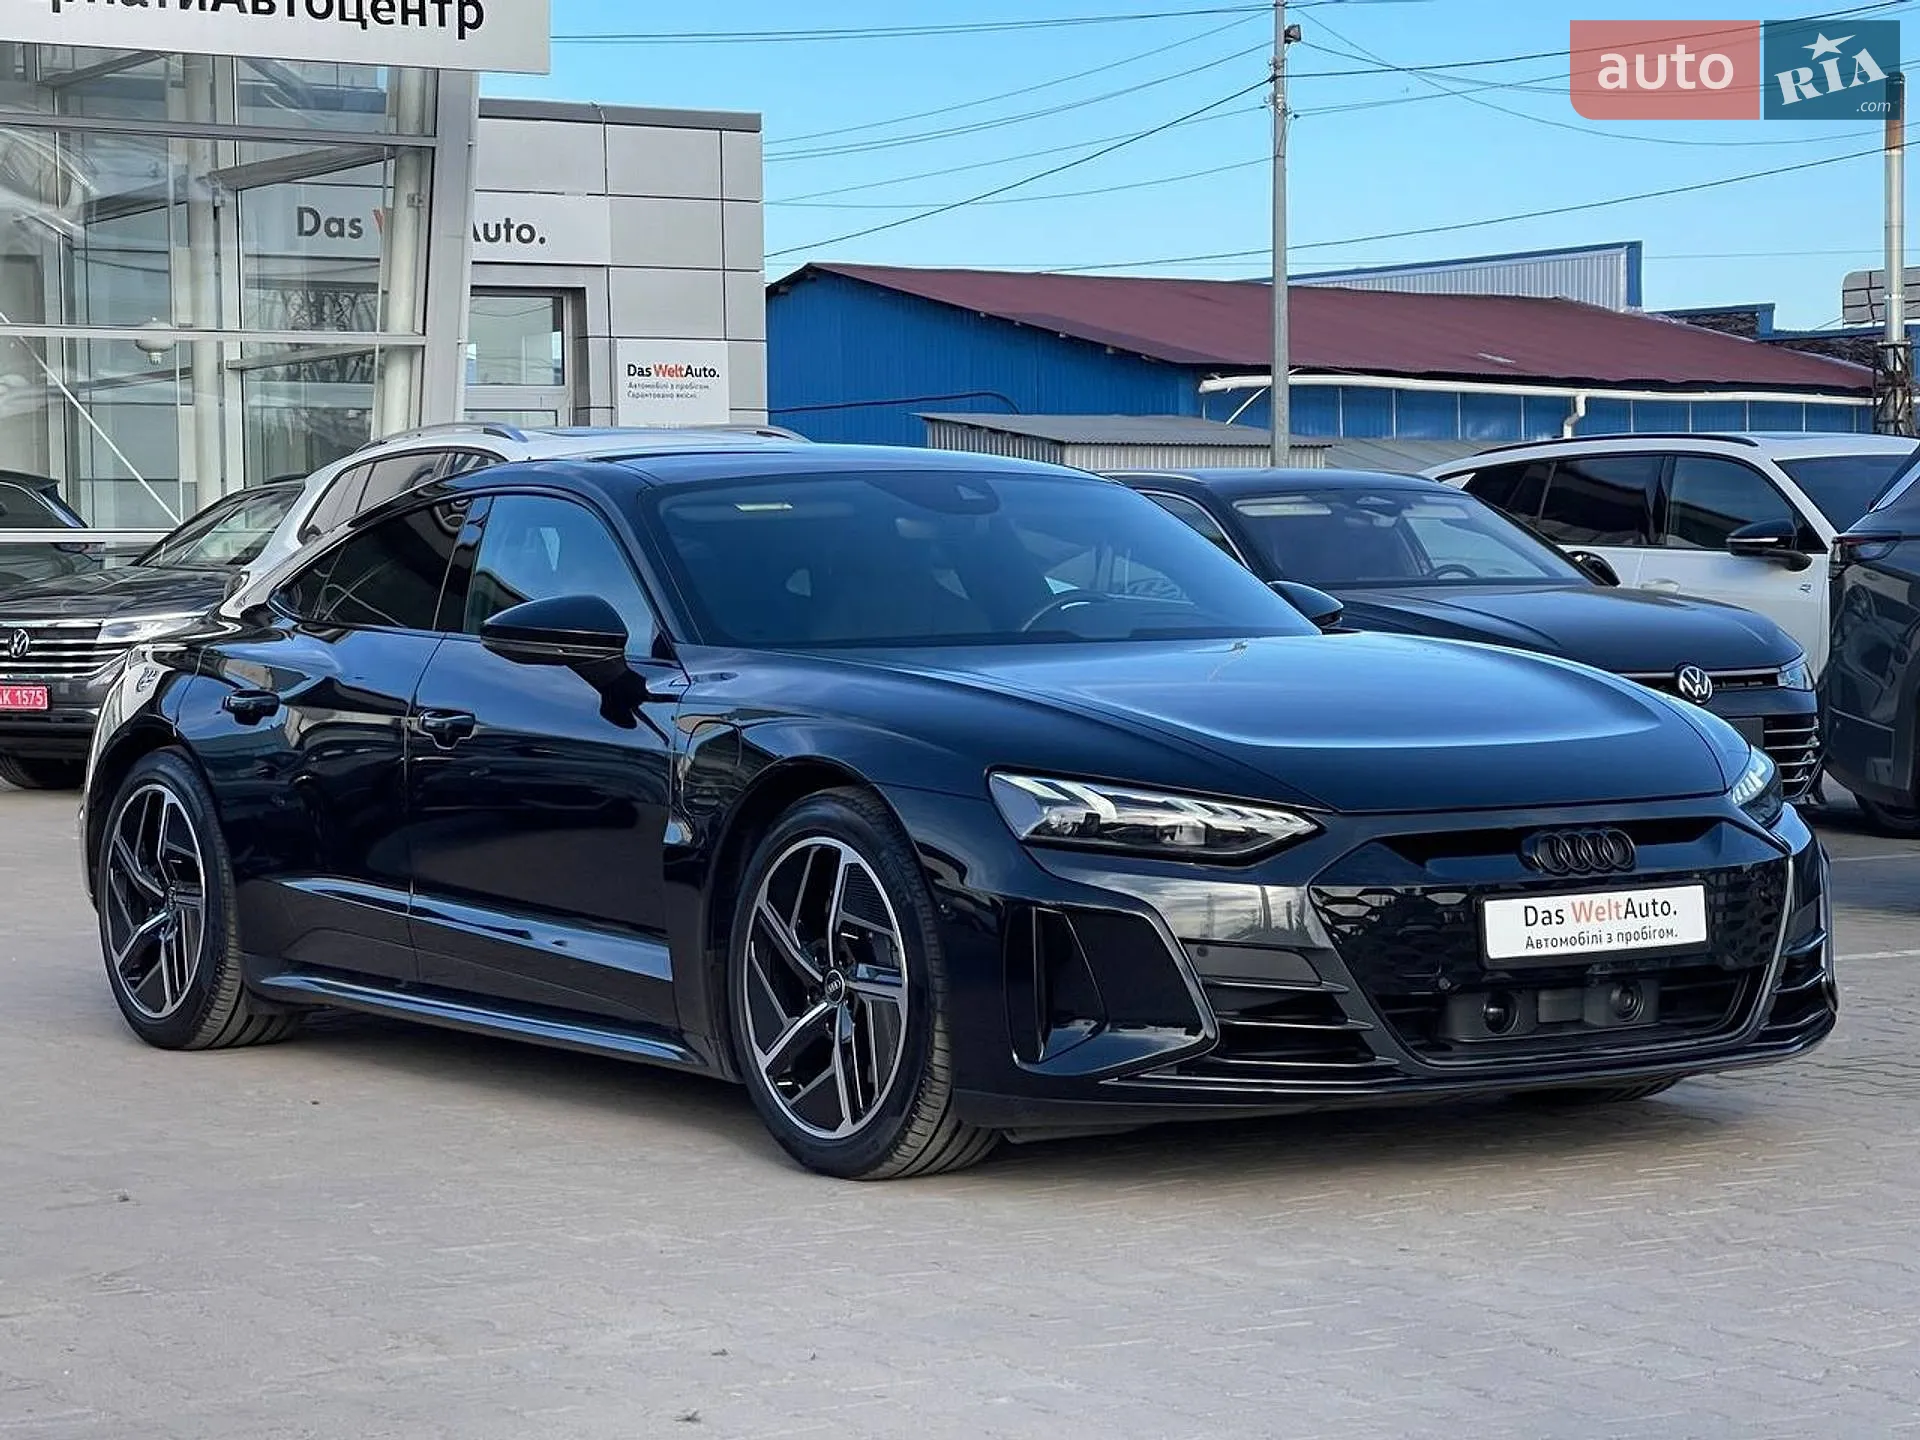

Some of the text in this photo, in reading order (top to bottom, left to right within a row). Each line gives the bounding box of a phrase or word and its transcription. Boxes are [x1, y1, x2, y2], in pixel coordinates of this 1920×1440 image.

[296, 206, 364, 239] Das
[627, 364, 720, 378] Das WeltAuto.
[16, 690, 44, 705] 1575
[1524, 897, 1678, 927] Das WeltAuto.
[1525, 925, 1678, 949] Автомобілі з пробігом.
